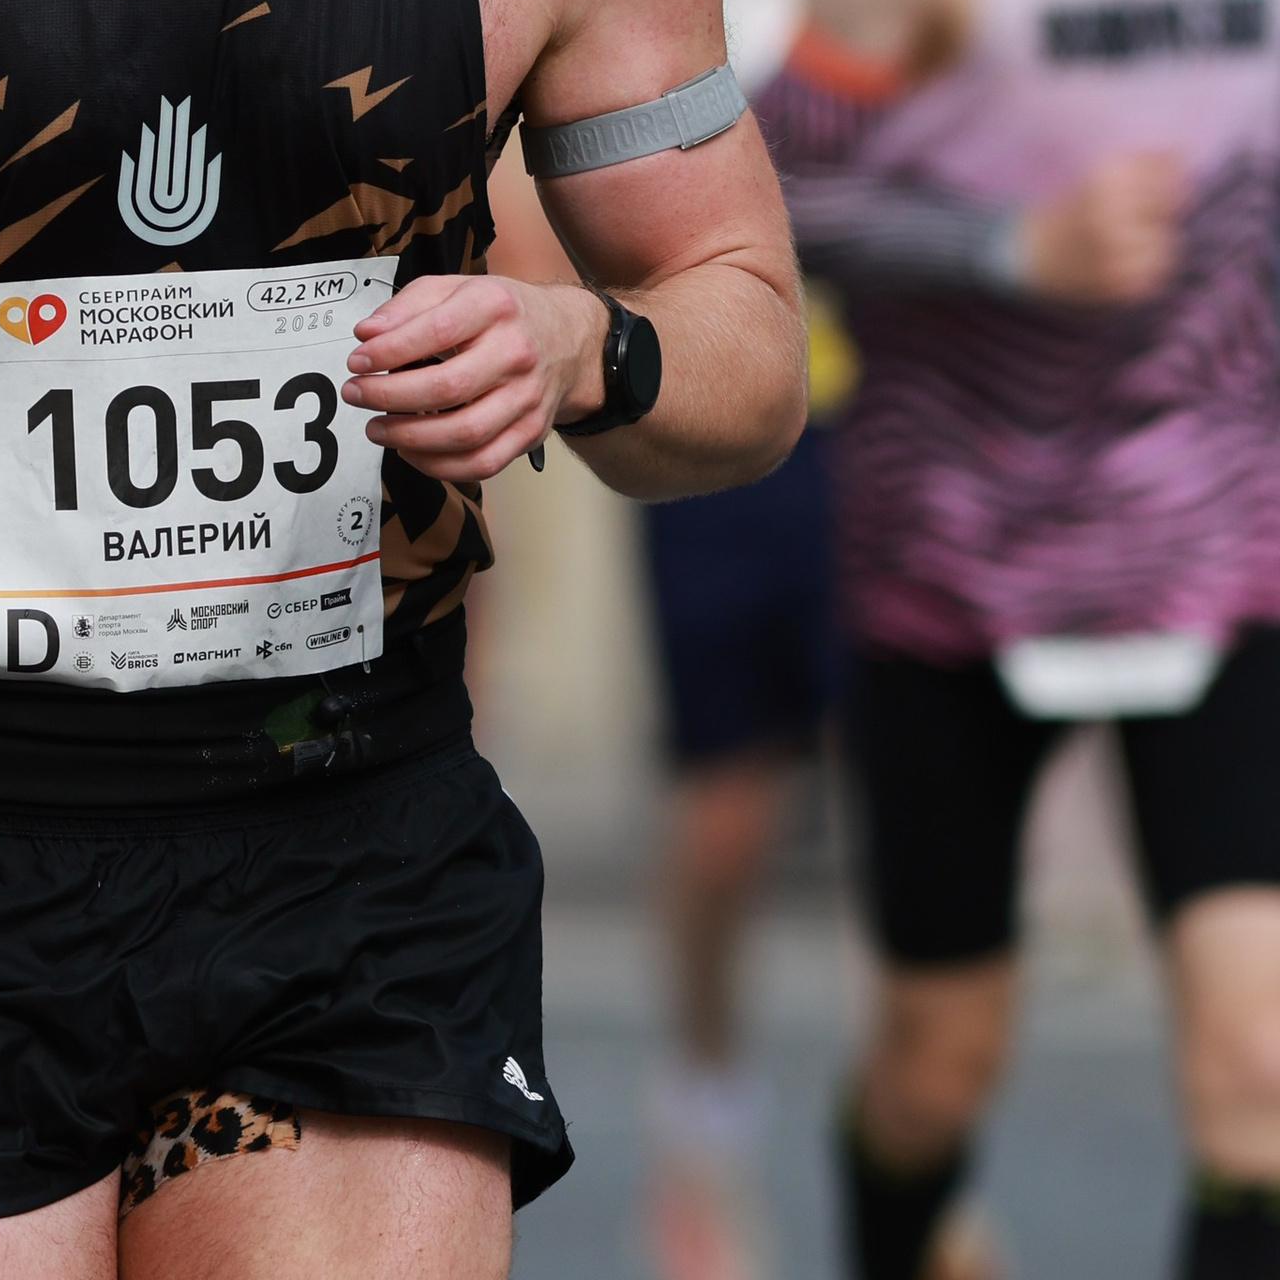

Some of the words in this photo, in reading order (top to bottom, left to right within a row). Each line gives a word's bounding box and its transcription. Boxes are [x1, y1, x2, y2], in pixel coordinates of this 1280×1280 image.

[547, 105, 676, 170] EXPLORE
[78, 284, 193, 305] СБЕРПРАЙМ
[260, 283, 306, 305] 42,2
[314, 277, 345, 299] КМ
[79, 298, 234, 325] МОСКОВСКИЙ
[274, 309, 334, 334] 2026
[80, 322, 193, 346] МАРАФОН
[26, 371, 339, 511] 1053
[350, 510, 363, 531] 2
[103, 512, 272, 562] ВАЛЕРИЙ
[190, 599, 249, 617] МОСКОВСКИЙ
[284, 598, 318, 614] СБЕР
[324, 592, 347, 607] Прайм
[98, 613, 141, 622] Департамент
[98, 622, 121, 630] спорта
[190, 617, 218, 631] СПОРТ
[6, 608, 60, 674] D
[274, 641, 293, 652] сбп
[310, 631, 342, 647] WINLINE
[128, 658, 158, 669] BRICS
